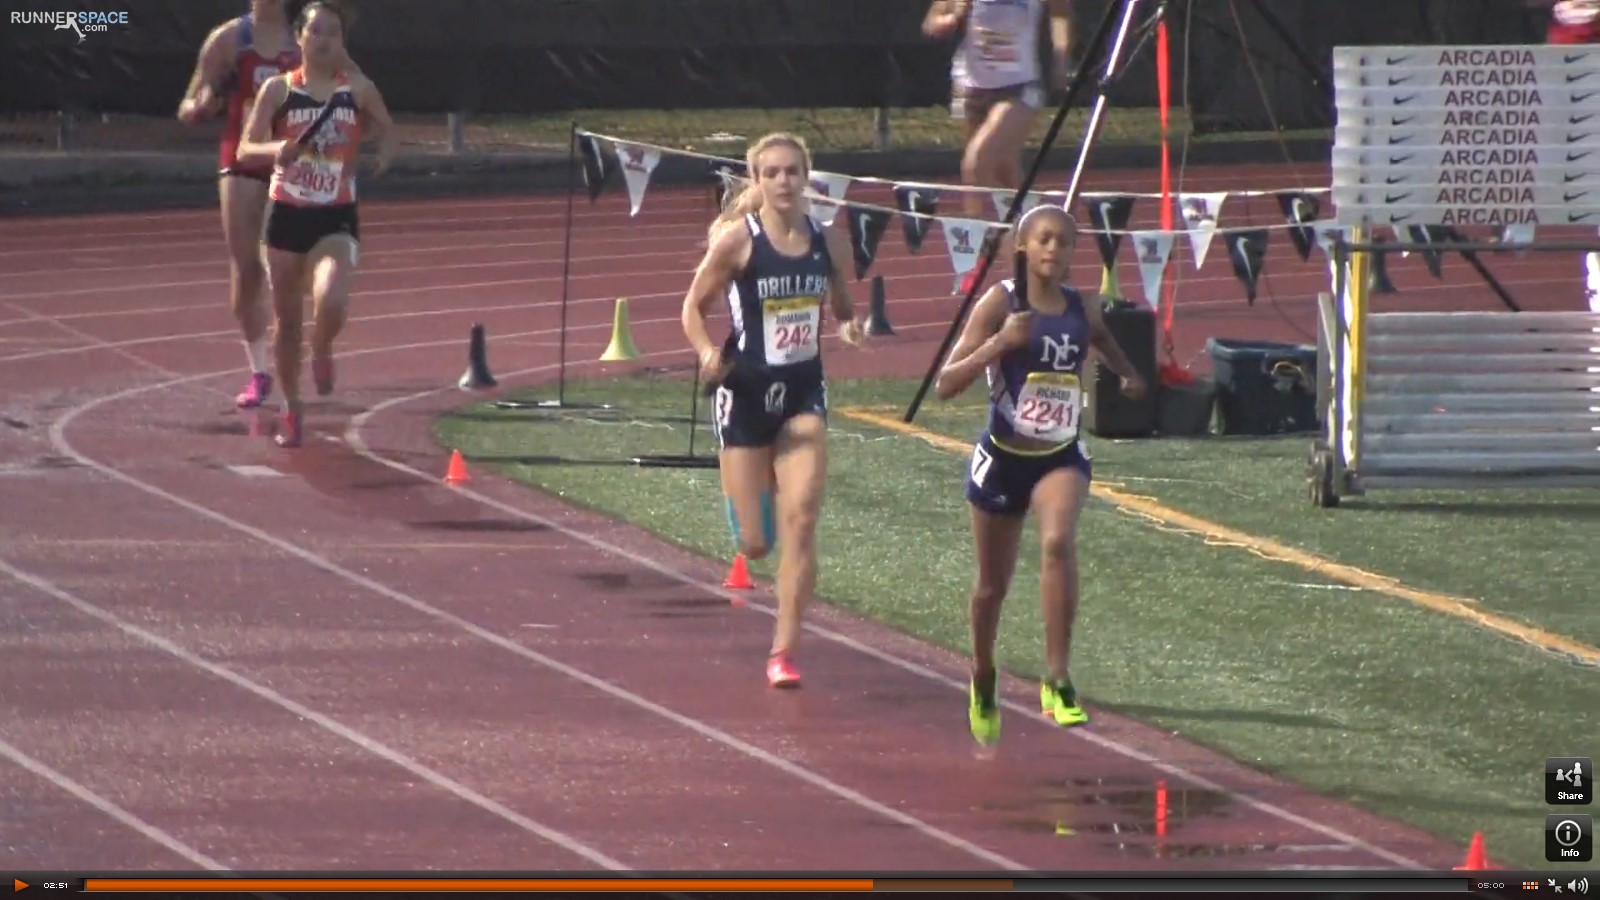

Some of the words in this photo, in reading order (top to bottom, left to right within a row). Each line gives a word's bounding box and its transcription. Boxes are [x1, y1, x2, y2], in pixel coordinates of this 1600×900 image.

[1438, 50, 1536, 66] ARCADIA
[1440, 69, 1537, 86] ARCADIA
[1444, 90, 1542, 106] ARCADIA
[1443, 110, 1540, 126] ARCADIA
[1440, 129, 1538, 145] ARCADIA
[1441, 149, 1538, 165] ARCADIA
[1438, 169, 1535, 184] ARCADIA
[1435, 187, 1535, 204] ARCADIA
[1441, 208, 1539, 224] ARCADIA
[775, 323, 812, 350] 242
[1020, 399, 1074, 428] 2241
[973, 448, 988, 477] 7
